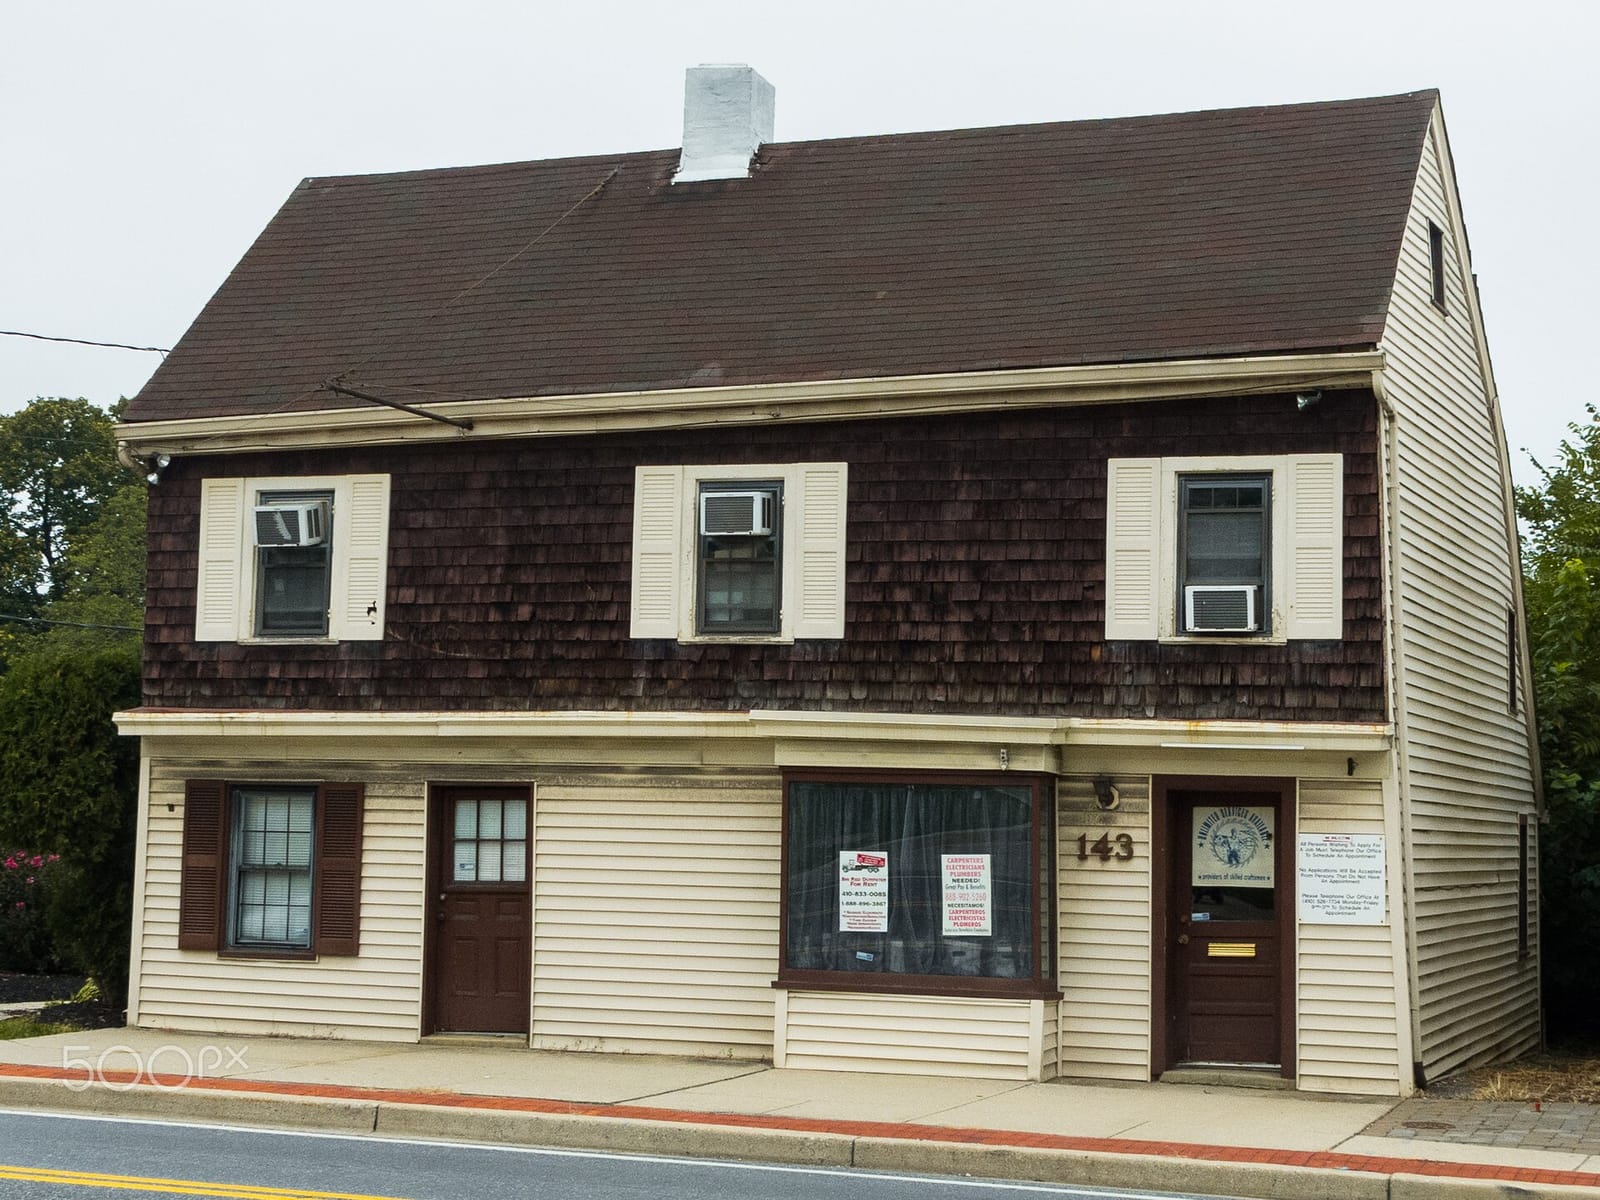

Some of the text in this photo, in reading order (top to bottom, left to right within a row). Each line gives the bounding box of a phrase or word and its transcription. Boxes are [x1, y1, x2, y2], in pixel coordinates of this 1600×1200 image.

[1198, 811, 1220, 840] UNLIMITED
[1220, 807, 1249, 819] SERVICES
[1077, 831, 1134, 861] 143
